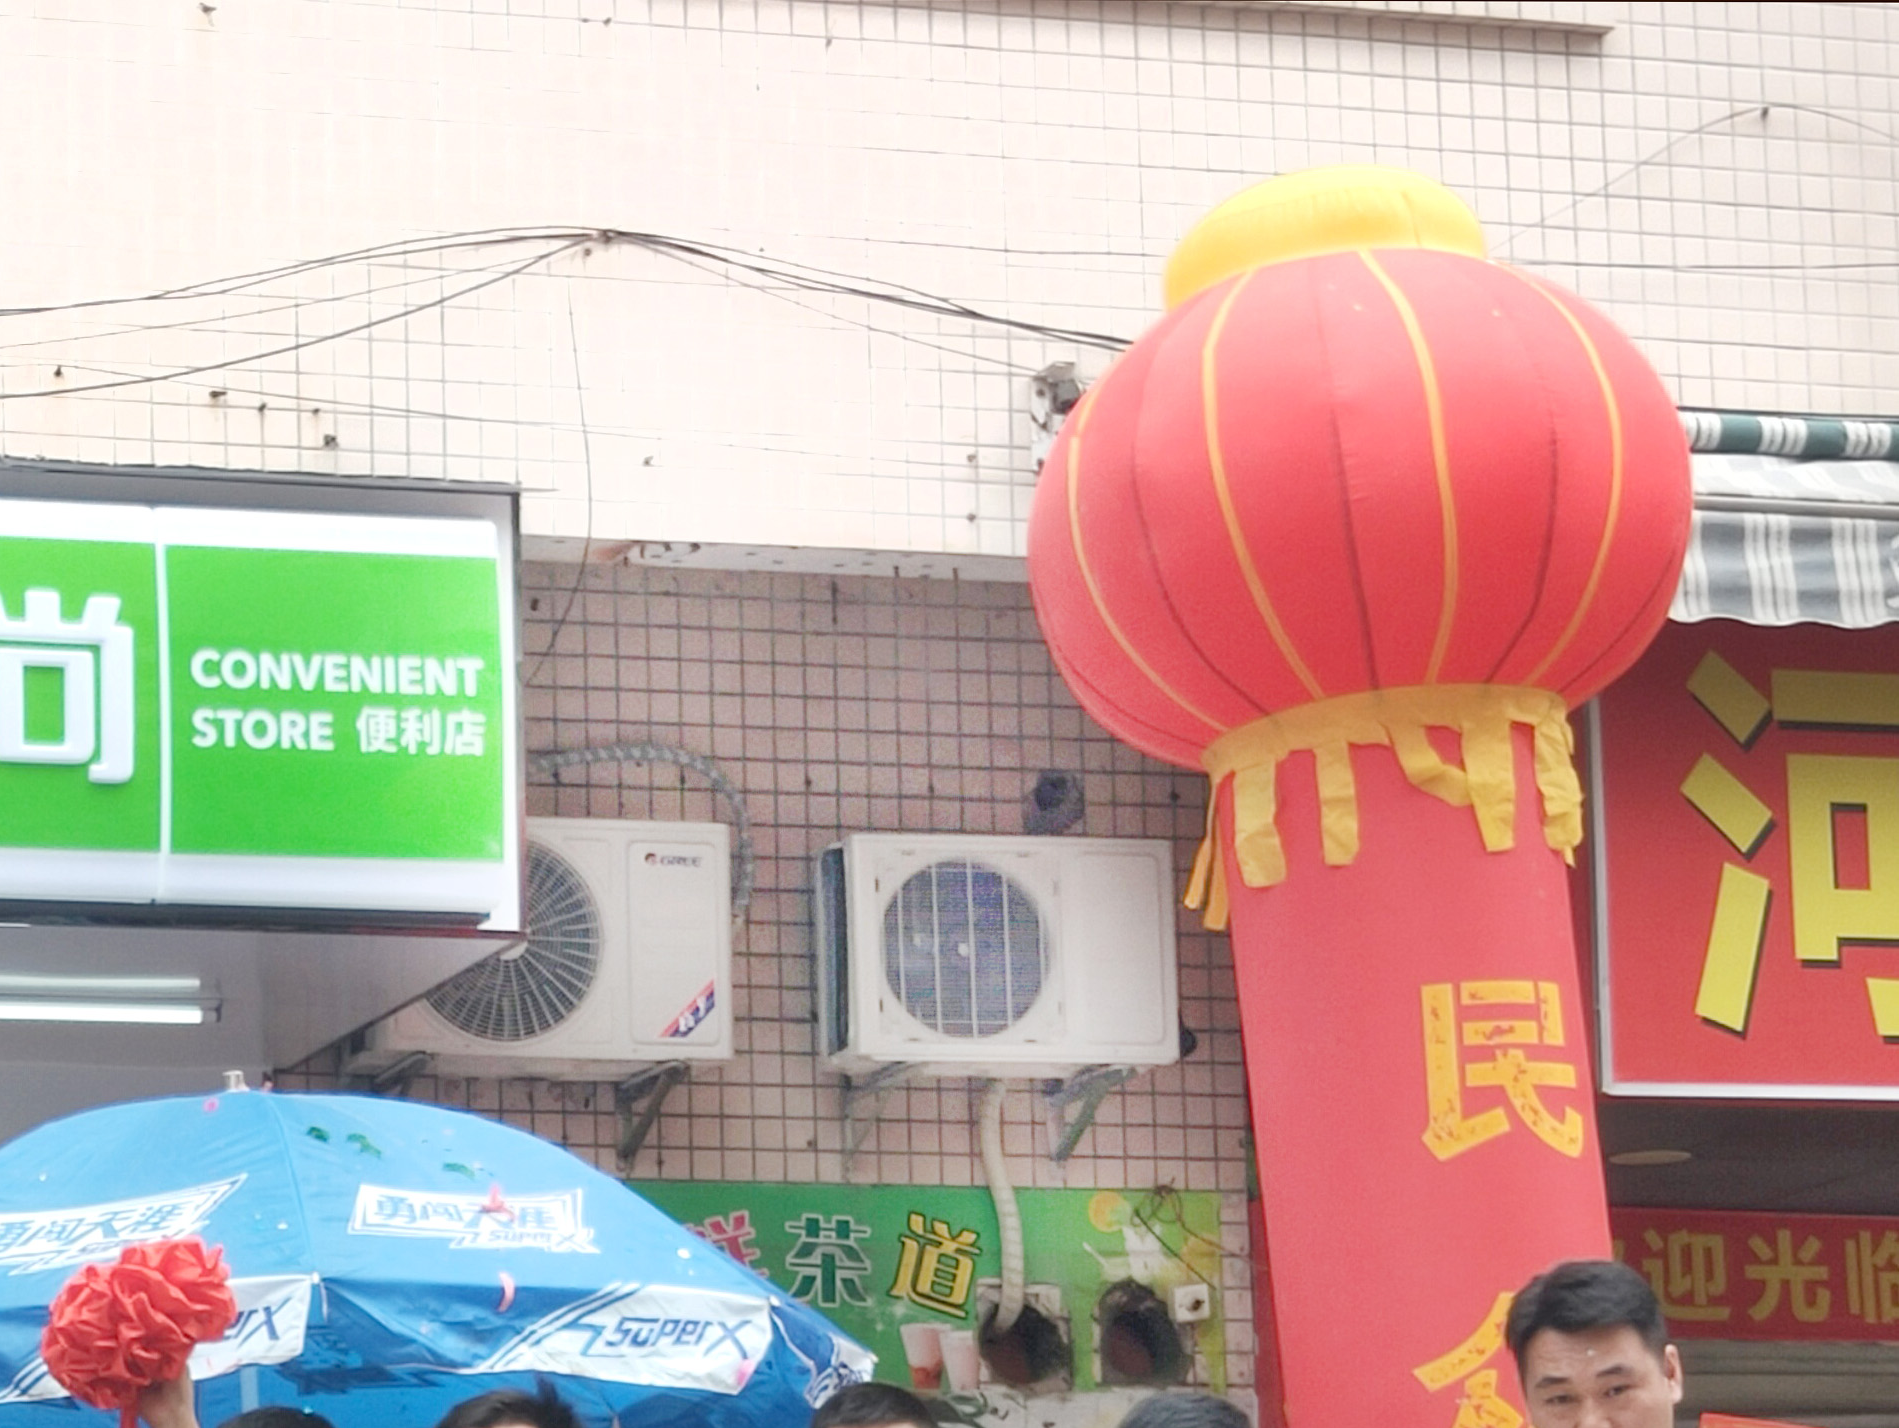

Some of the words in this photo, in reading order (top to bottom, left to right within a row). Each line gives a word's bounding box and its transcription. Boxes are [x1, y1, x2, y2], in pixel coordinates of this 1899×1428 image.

[190, 647, 486, 698] CONVENIENT
[191, 707, 336, 752] STORE
[355, 706, 488, 758] 便利店
[1613, 1229, 1899, 1324] 迎光临
